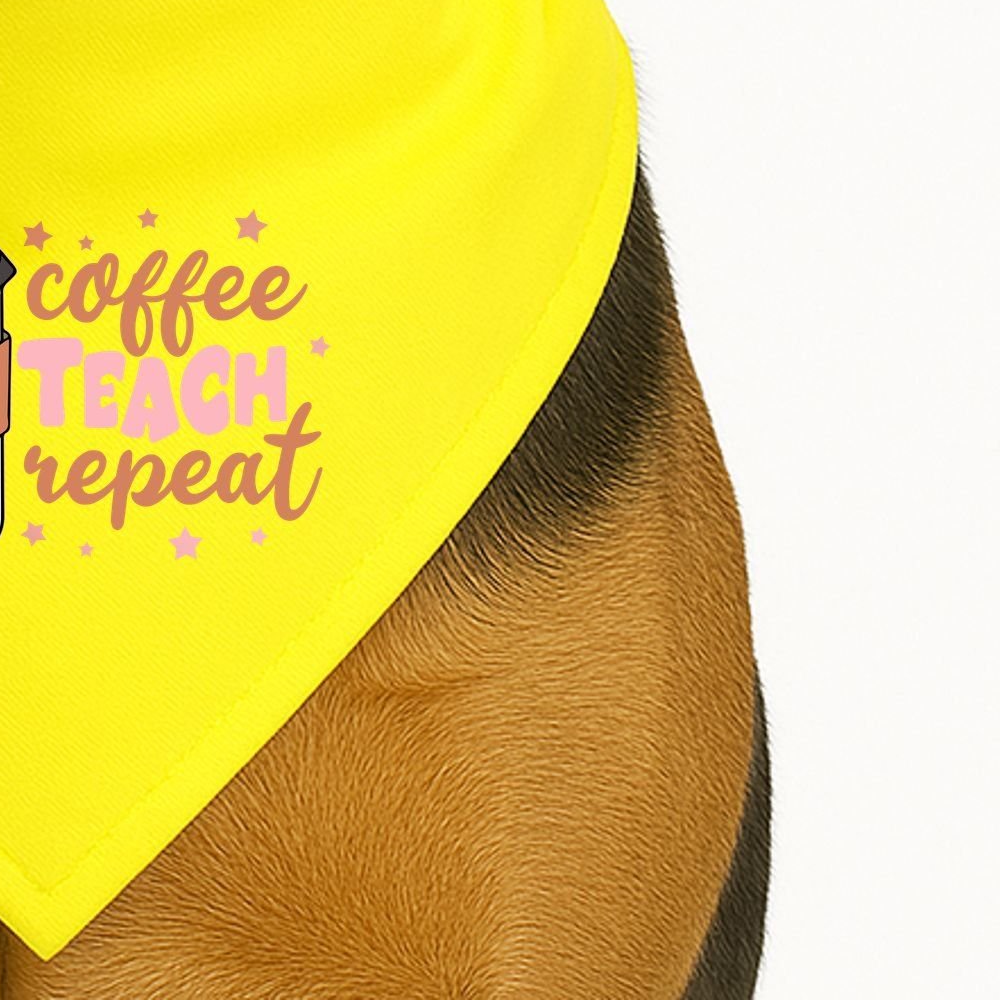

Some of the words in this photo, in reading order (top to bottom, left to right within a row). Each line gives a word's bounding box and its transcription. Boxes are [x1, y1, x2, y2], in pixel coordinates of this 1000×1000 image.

[27, 250, 307, 356] coffee
[18, 338, 288, 442] TEACH
[24, 402, 322, 530] repeat
